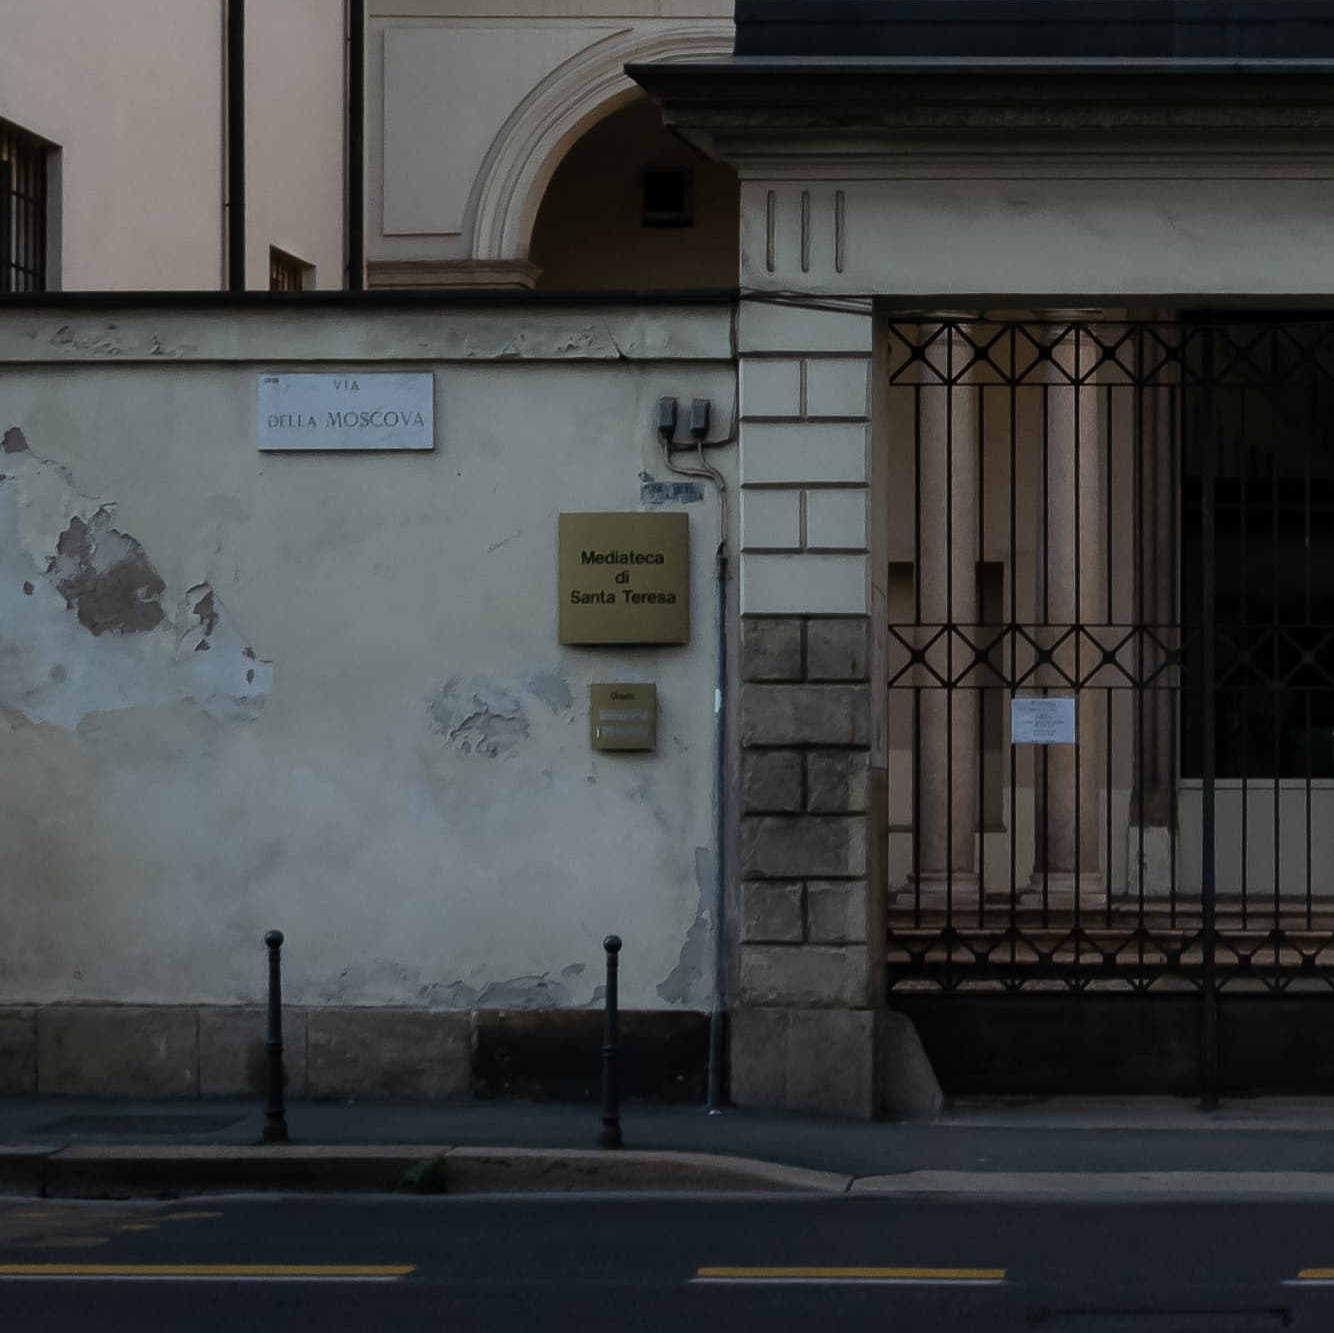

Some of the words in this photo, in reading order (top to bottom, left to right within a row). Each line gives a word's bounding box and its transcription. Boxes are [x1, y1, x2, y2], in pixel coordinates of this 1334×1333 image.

[333, 380, 360, 391] VIA
[267, 414, 317, 429] DELLA
[326, 411, 425, 429] MOSCOVA
[581, 550, 665, 565] Mediateca
[615, 570, 630, 584] di
[570, 590, 616, 605] Santa
[622, 589, 677, 605] Teresa
